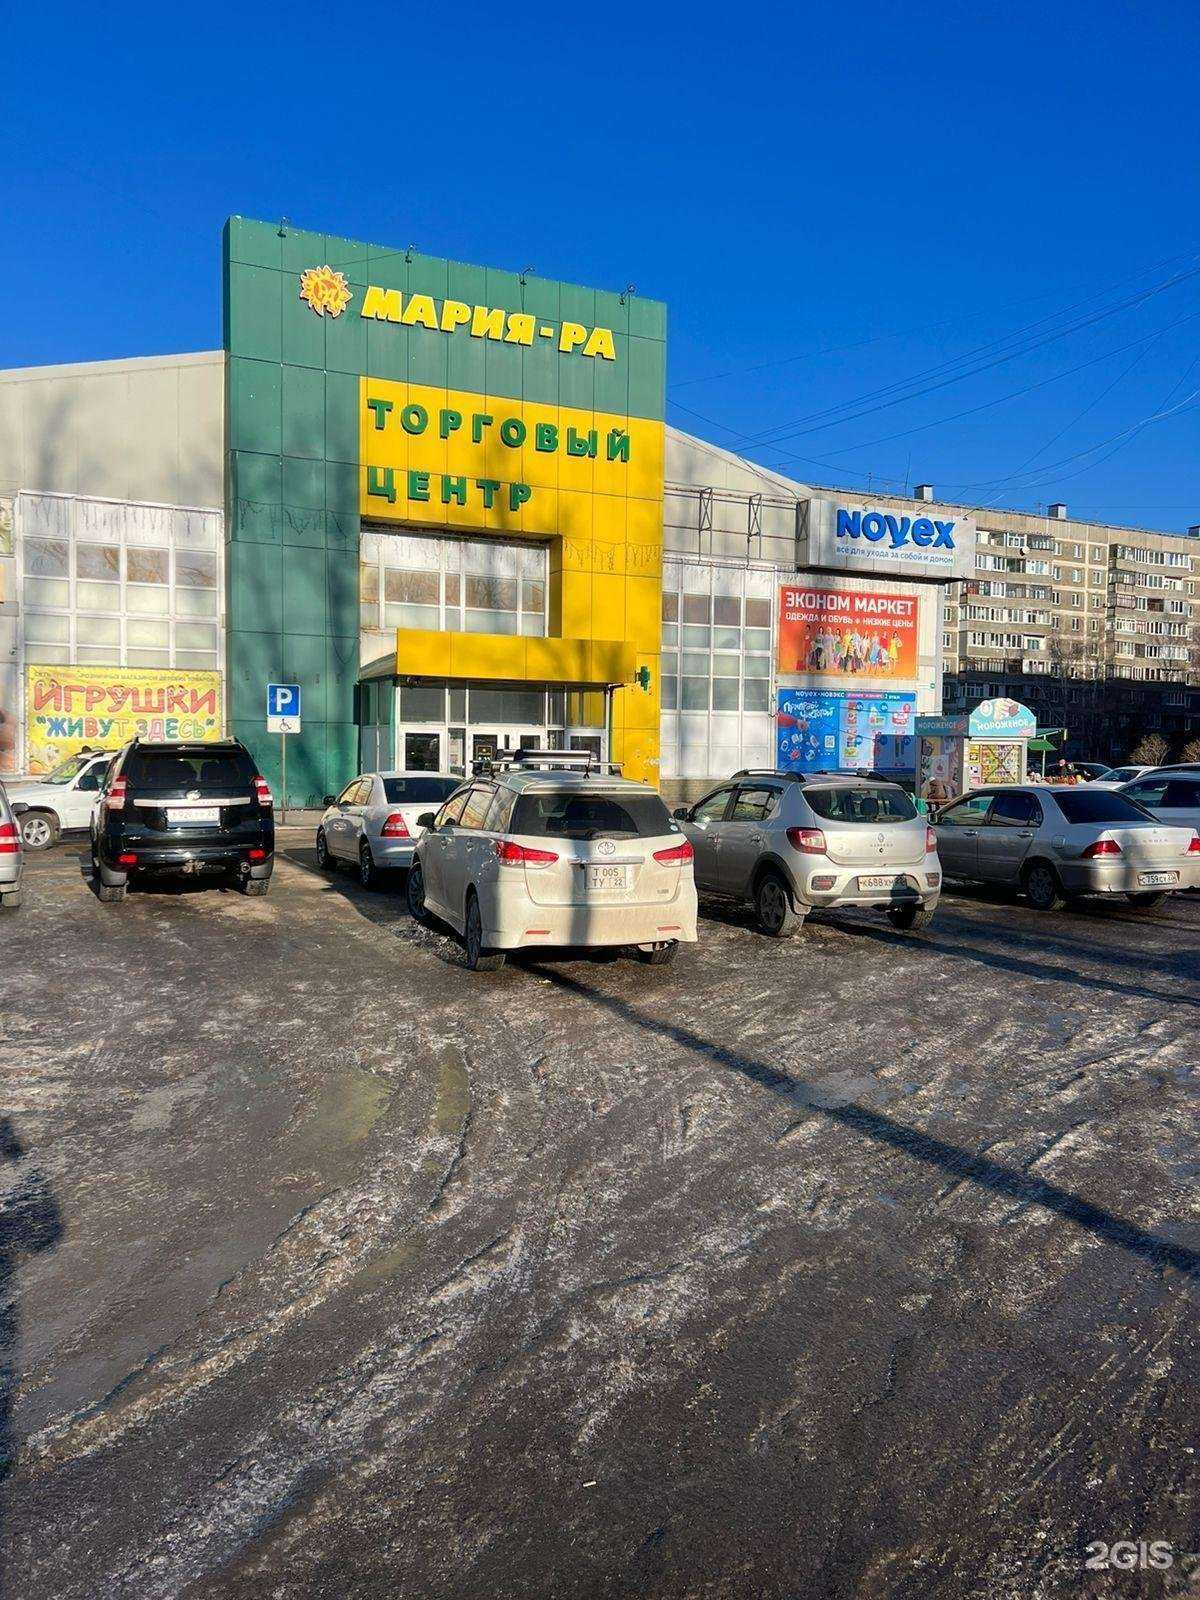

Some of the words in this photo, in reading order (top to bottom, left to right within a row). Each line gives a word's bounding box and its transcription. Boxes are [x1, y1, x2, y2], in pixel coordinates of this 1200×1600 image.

[361, 286, 616, 360] МАРИЯ-РА
[367, 398, 630, 462] ТОРГОВЫЙ
[367, 466, 532, 511] ЦЕНТР
[866, 549, 889, 557] ухода
[900, 552, 923, 561] собой
[785, 592, 850, 611] ЭКОНОМ
[855, 598, 914, 615] МАРКЕТ
[785, 612, 818, 622] ОДЕЖДА
[821, 614, 827, 622] И
[828, 615, 853, 624] ОБУВЬ
[863, 618, 890, 627] НИЗКИЕ
[892, 619, 914, 628] ЦЕНЫ
[276, 688, 292, 711] P
